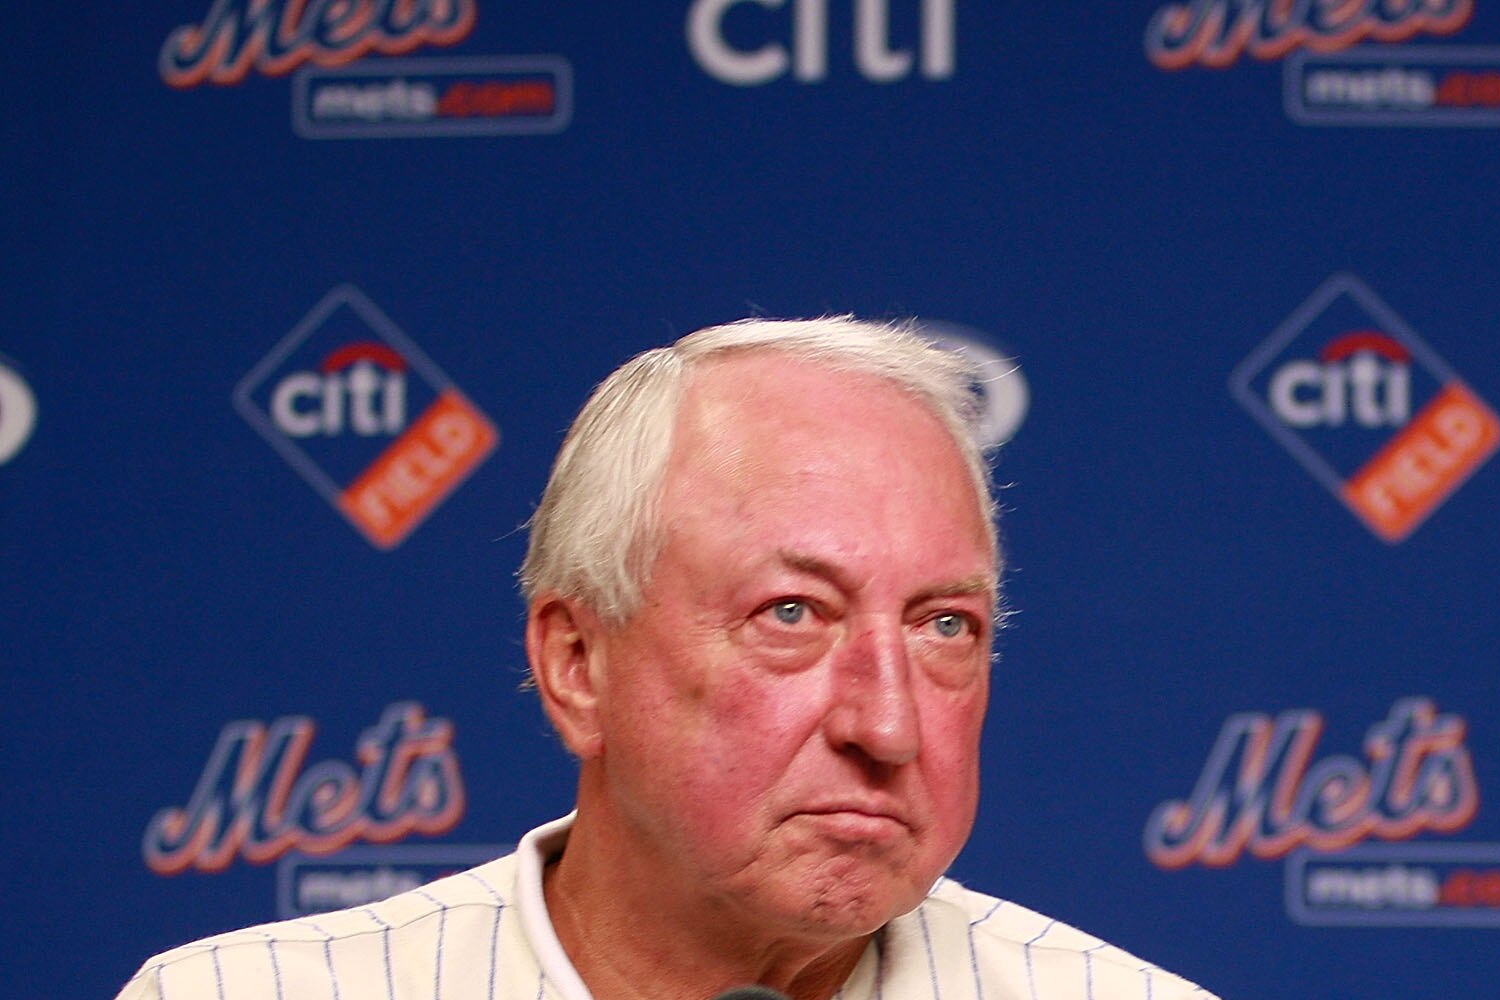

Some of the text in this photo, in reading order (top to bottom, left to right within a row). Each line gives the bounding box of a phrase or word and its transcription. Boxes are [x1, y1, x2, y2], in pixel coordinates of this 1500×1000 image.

[311, 80, 556, 120] mets.com
[270, 360, 407, 437] citi
[1267, 350, 1411, 427] citi
[352, 408, 477, 530] FIELD
[1358, 402, 1484, 525] FIELD
[143, 700, 466, 875] Mets
[1143, 696, 1480, 869] Mets
